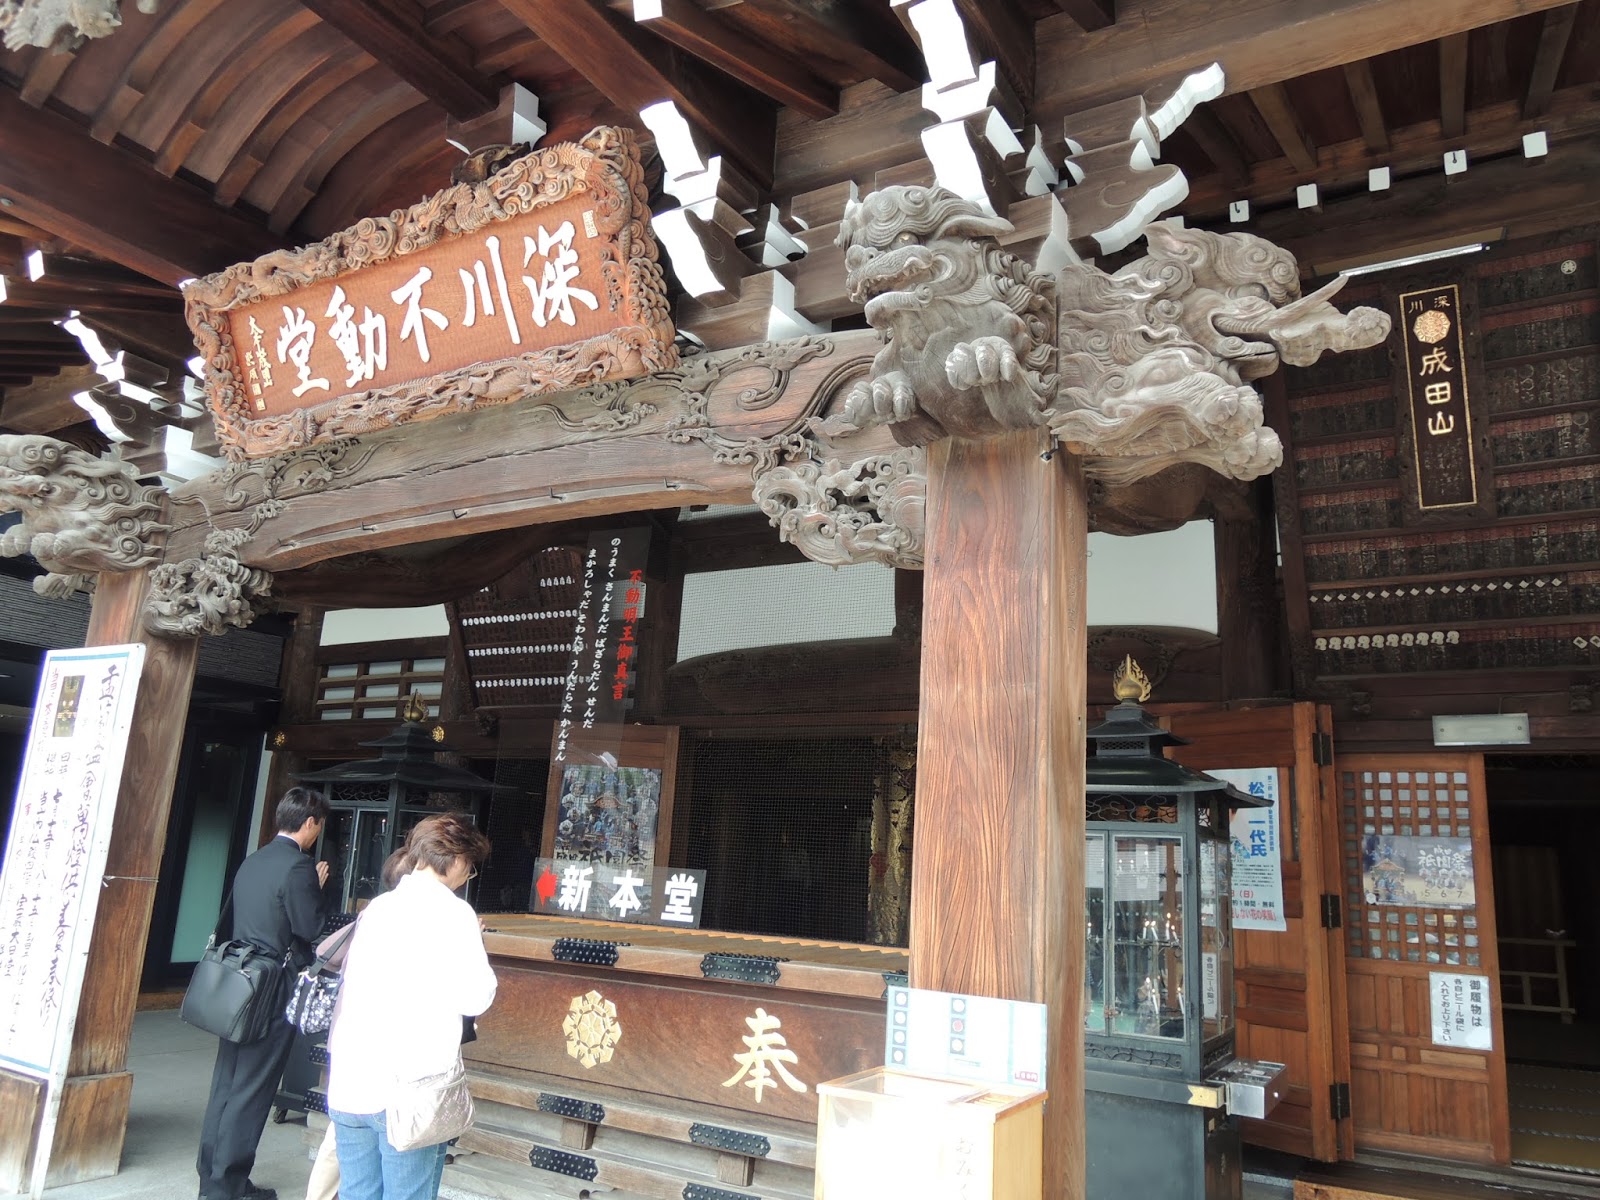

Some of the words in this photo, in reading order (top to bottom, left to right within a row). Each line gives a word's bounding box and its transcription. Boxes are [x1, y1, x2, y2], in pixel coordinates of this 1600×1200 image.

[276, 220, 599, 397] 深川不動堂
[1408, 295, 1450, 313] 深川
[1419, 347, 1454, 435] 成田山
[612, 569, 642, 700] 不動明王御真言
[1248, 781, 1267, 857] 松一代氏
[558, 865, 699, 923] 新本堂
[1441, 890, 1447, 898] 6
[1457, 890, 1463, 898] 7
[1469, 980, 1482, 1027] 御履物は
[721, 1007, 807, 1103] 奉
